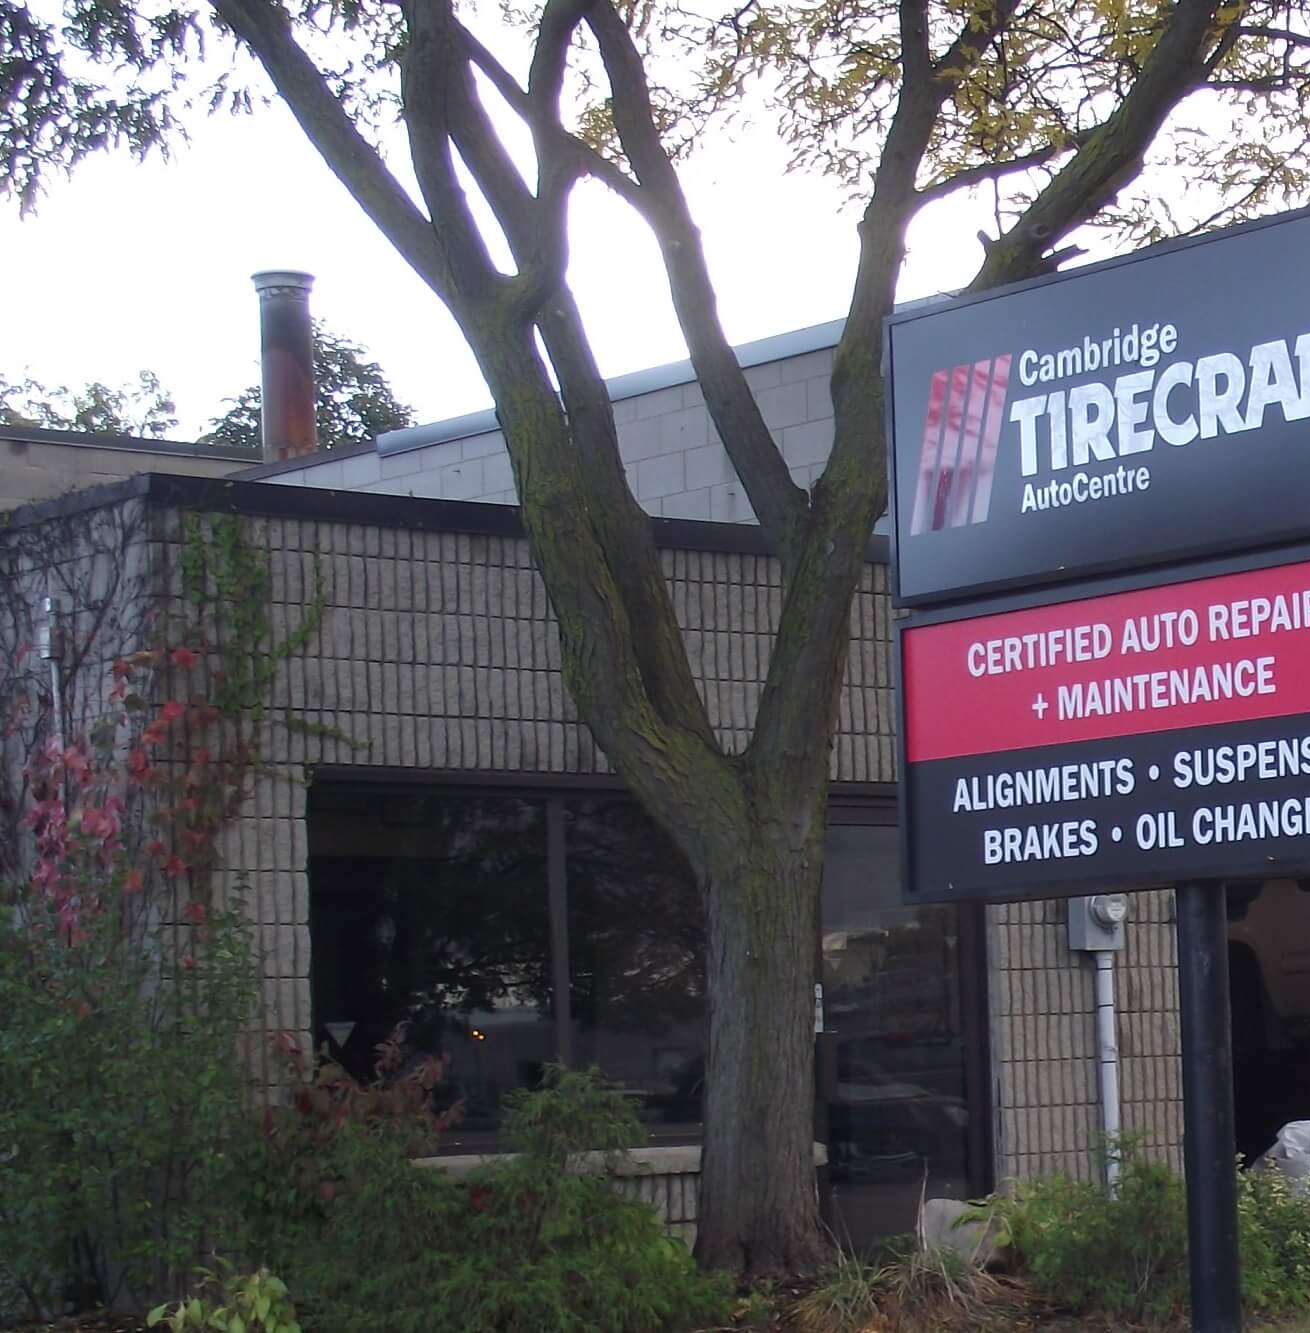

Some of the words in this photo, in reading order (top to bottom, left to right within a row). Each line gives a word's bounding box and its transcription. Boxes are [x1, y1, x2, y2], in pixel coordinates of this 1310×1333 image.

[1019, 322, 1178, 386] Cambridge
[1020, 465, 1151, 514] AutoCentre
[967, 623, 1113, 677] CERTIFIED
[1121, 611, 1199, 655] AUTO
[1057, 656, 1276, 721] MAINTENANCE
[953, 758, 1135, 813] ALIGNMENTS
[984, 819, 1098, 865] BRAKES
[1136, 811, 1185, 850] OIL
